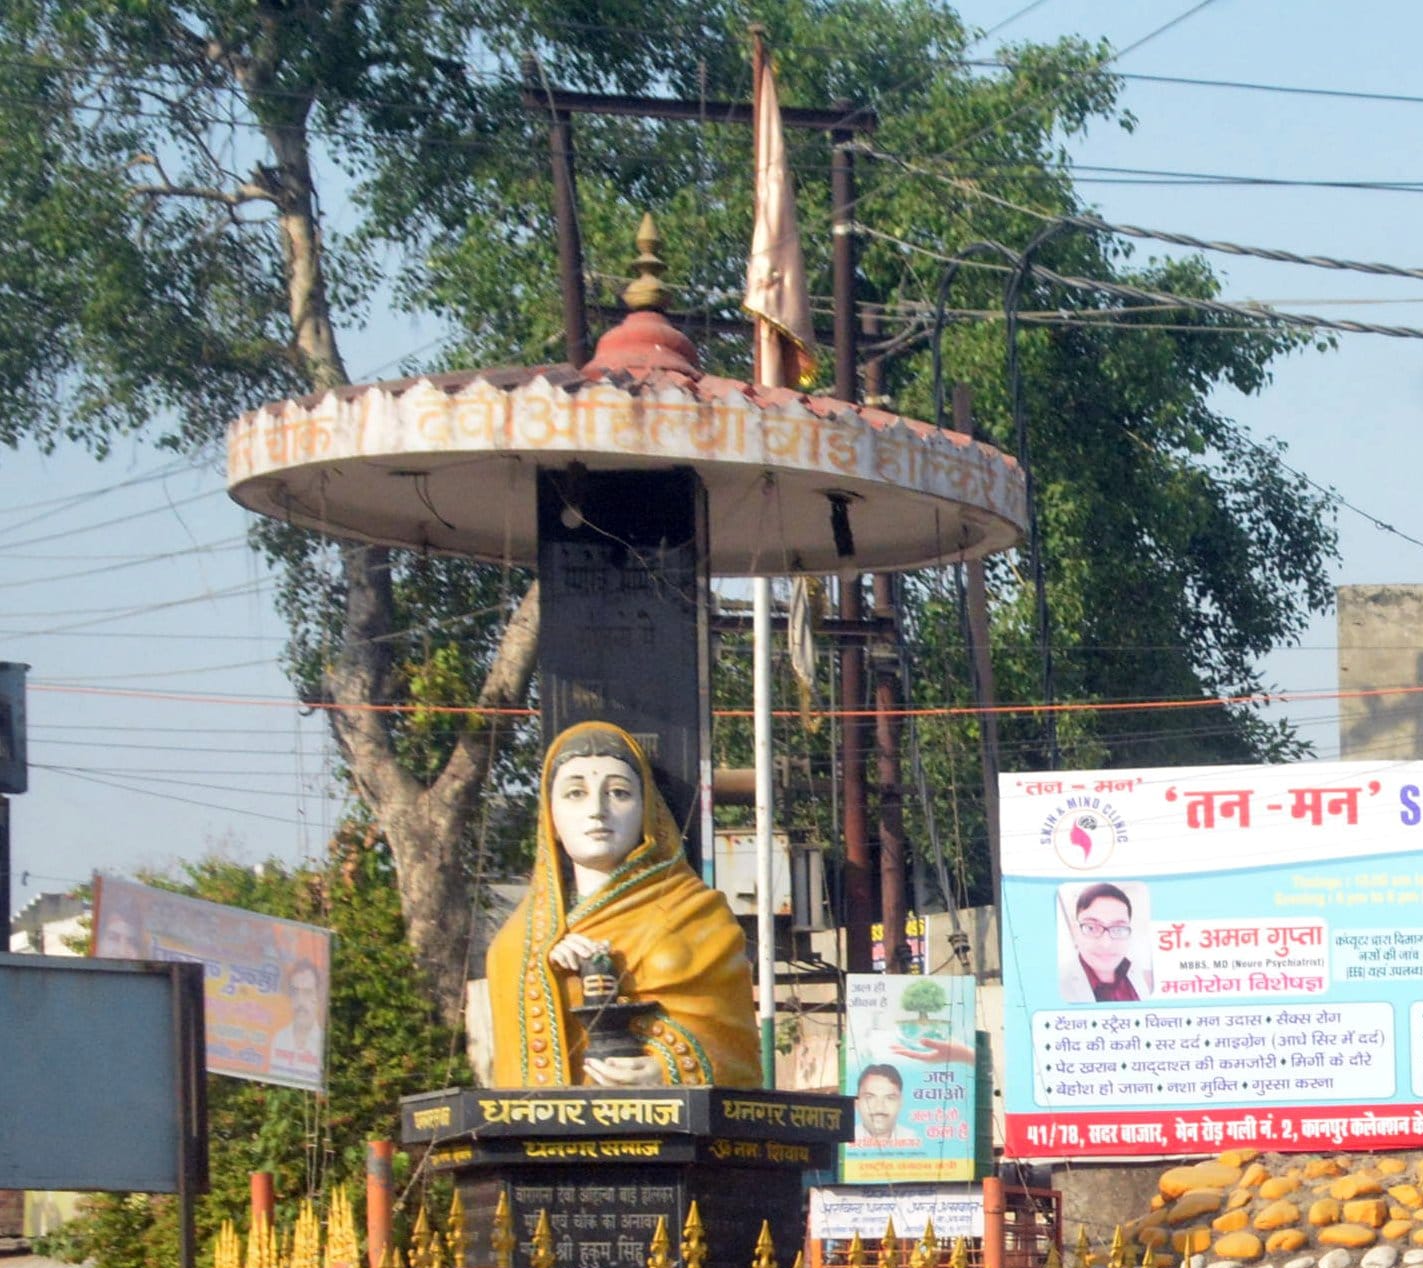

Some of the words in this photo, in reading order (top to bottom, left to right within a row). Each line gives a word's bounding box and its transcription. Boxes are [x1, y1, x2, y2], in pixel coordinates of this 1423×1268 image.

[1067, 796, 1100, 810] MIND
[1158, 922, 1190, 951] डॉ.
[1199, 928, 1259, 950] अमन
[1267, 925, 1323, 957] गुप्ता
[1213, 958, 1229, 969] MD
[1161, 974, 1241, 994] मनोरोग
[1249, 972, 1324, 993] विशेषज्ञ
[1196, 1016, 1220, 1027] मन
[1225, 1014, 1262, 1027] उदास
[1316, 1009, 1342, 1024] रोग
[1086, 1036, 1105, 1051] की
[1110, 1035, 1141, 1050] कमी
[1155, 1038, 1176, 1050] सर
[1180, 1033, 1200, 1049] दर्द
[1214, 1033, 1266, 1049] माइग्रेन
[1271, 1031, 1307, 1050] (आधे
[1311, 1030, 1338, 1047] सिर
[1341, 1030, 1356, 1045] में
[1358, 1029, 1386, 1048] दर्द)
[1055, 1059, 1076, 1074] पेट
[1079, 1062, 1117, 1074] खराब
[1195, 1055, 1214, 1071] की
[1219, 1053, 1277, 1070] कमजोरी
[1290, 1052, 1325, 1068] मिर्गी
[1329, 1052, 1344, 1067] के
[1056, 1081, 1094, 1097] बेहोश
[1098, 1080, 1114, 1096] हो
[1118, 1082, 1154, 1095] जाना
[1167, 1081, 1196, 1093] नशा
[1200, 1076, 1238, 1098] मुक्ति
[1252, 1078, 1290, 1096] गुस्सा
[478, 1099, 587, 1125] धनगर
[591, 1099, 684, 1126] समाज
[722, 1100, 788, 1127] धनगर
[790, 1105, 842, 1130] समाज
[1088, 1123, 1118, 1144] सदर
[1120, 1122, 1168, 1147] बाजार,
[1175, 1117, 1198, 1144] मेन
[1226, 1114, 1257, 1141] गली
[1301, 1118, 1349, 1144] कानपुर
[523, 1141, 598, 1157] धनगर
[600, 1140, 663, 1157] समाज
[601, 1214, 616, 1228] का
[556, 1234, 573, 1262] श्री
[617, 1234, 645, 1267] सिंह
